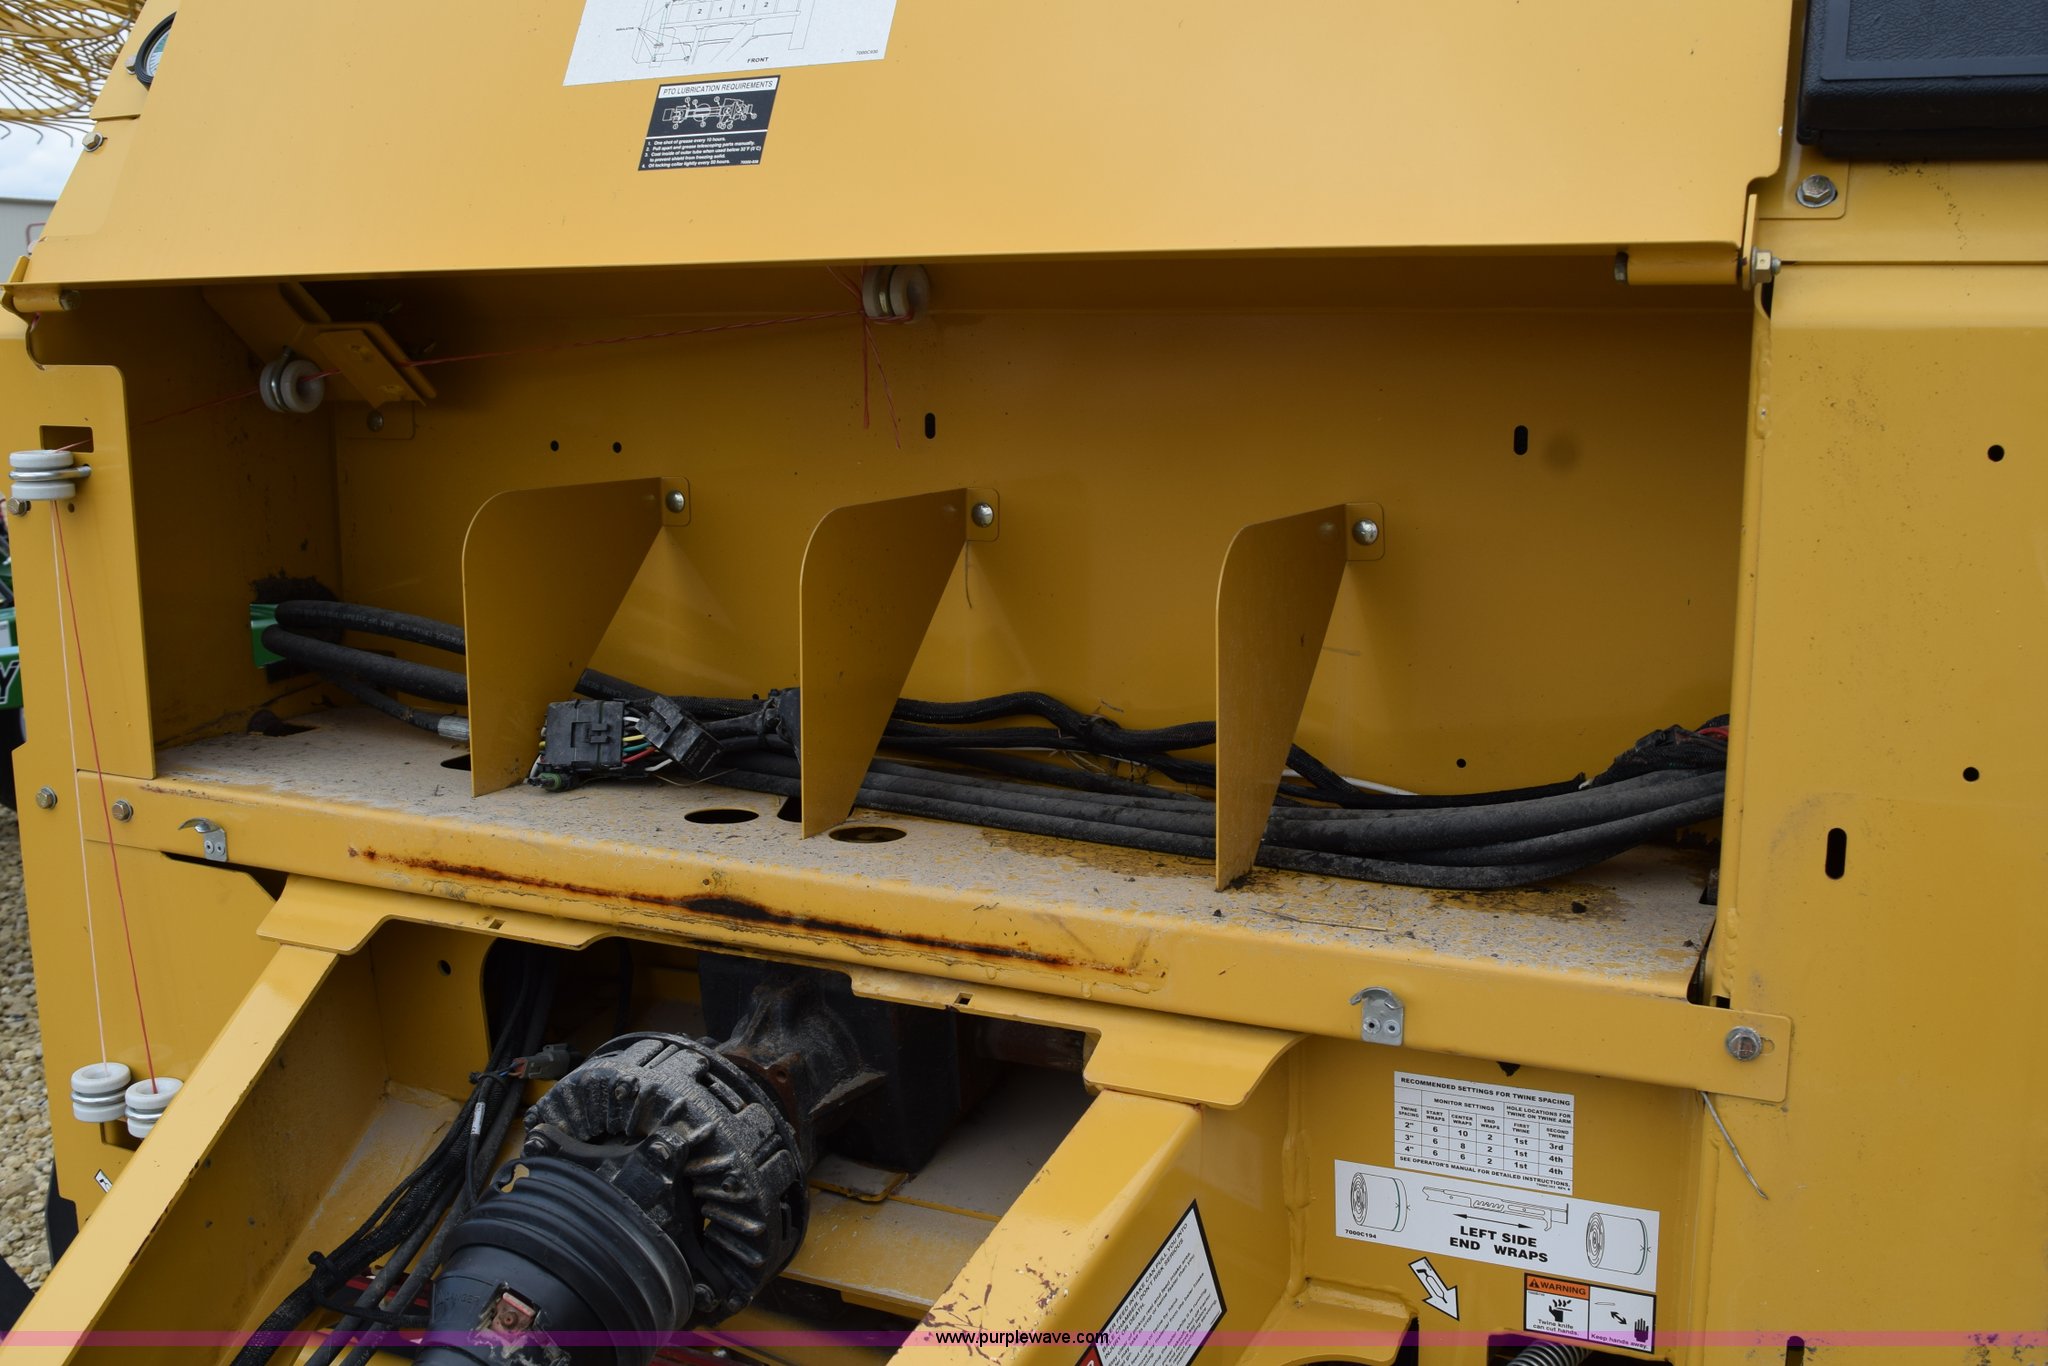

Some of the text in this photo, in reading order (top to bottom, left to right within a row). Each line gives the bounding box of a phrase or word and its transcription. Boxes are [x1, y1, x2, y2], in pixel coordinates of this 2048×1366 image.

[663, 80, 773, 95] PTO LUBRICATION REQUIREMENTS
[1401, 1078, 1455, 1090] RECOMMENDED
[1458, 1086, 1493, 1095] SETTINGS
[1539, 1097, 1570, 1106] SPACING
[1434, 1098, 1494, 1111] MONITOR SETTINGS
[1524, 1108, 1557, 1117] LOCATIONS
[1549, 1143, 1563, 1151] 3rd
[1549, 1155, 1563, 1163] 4th
[1412, 1159, 1449, 1168] OPERATOR'S
[1492, 1171, 1521, 1180] DETAILED
[1523, 1176, 1570, 1187] INSTRUCTIONS.
[1549, 1167, 1563, 1175] 4th
[1345, 1229, 1377, 1239] 7000C194
[1460, 1226, 1537, 1247] LEFT SIDE
[1450, 1236, 1548, 1263] END WRAPS
[1116, 1305, 1128, 1322] FEED
[1129, 1282, 1145, 1305] INTAKE
[1145, 1268, 1155, 1282] CAN
[1155, 1252, 1166, 1268] PULL
[1167, 1238, 1177, 1252] YOU
[1177, 1223, 1187, 1238] INTO
[1139, 1281, 1152, 1300] DON'T
[1153, 1265, 1164, 1280] RISK
[1164, 1238, 1183, 1266] SERIOUS
[1540, 1281, 1586, 1295] WARNING
[1558, 1328, 1579, 1336] hands.
[1591, 1333, 1607, 1341] Keep
[1609, 1336, 1629, 1345] hands
[1104, 1336, 1120, 1359] INJURY
